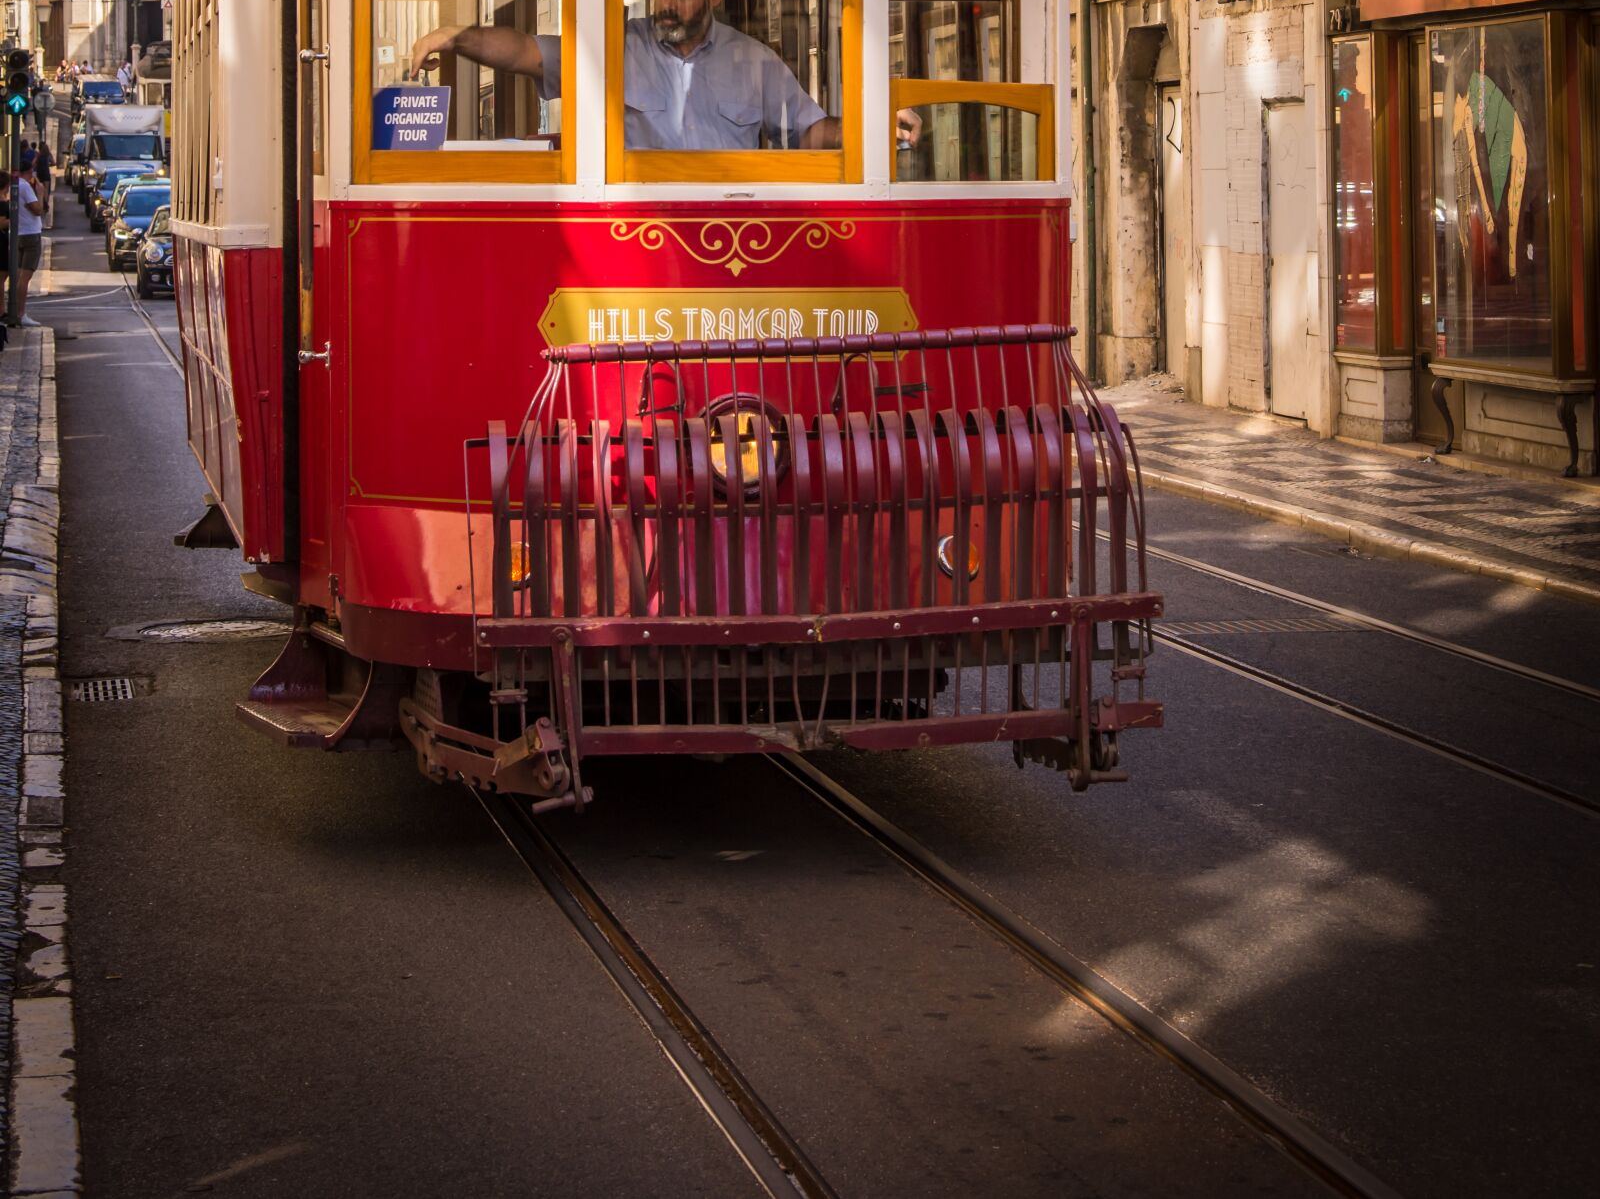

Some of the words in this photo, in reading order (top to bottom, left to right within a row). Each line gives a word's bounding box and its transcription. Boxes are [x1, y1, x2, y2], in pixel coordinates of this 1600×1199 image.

[393, 95, 438, 108] PRIVATE
[384, 112, 444, 125] ORGANIZED
[398, 129, 428, 142] TOUR
[588, 308, 674, 342] HILLS
[681, 308, 804, 341] TRAMCAR
